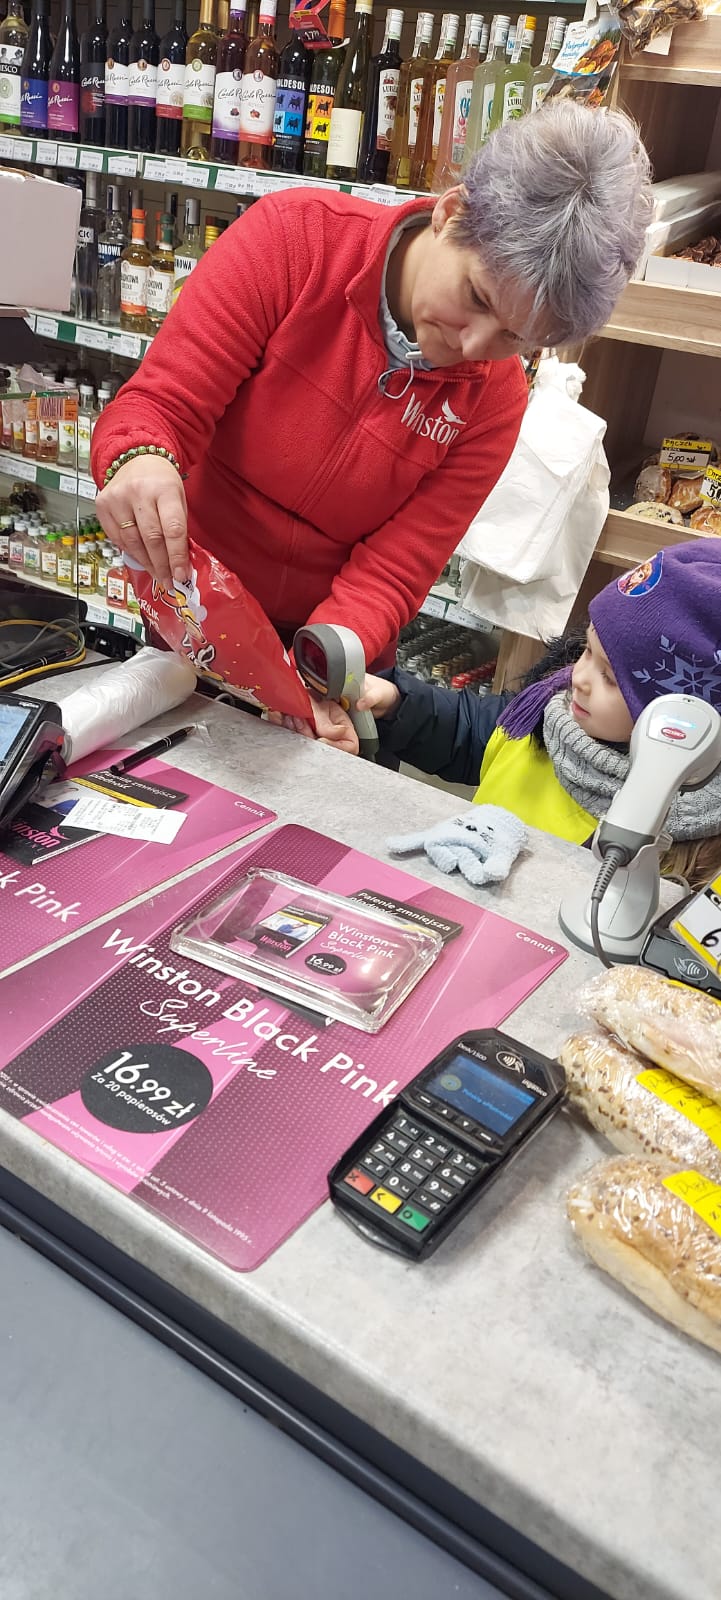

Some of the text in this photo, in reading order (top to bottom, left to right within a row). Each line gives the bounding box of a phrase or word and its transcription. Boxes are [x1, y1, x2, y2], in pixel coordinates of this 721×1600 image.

[401, 392, 459, 446] Winston
[234, 801, 266, 818] Cennik
[11, 820, 61, 849] inston
[13, 882, 82, 924] Pink
[358, 892, 452, 932] Palenie zmniejsza
[339, 922, 389, 947] Winston
[515, 930, 557, 955] Cennik
[328, 930, 395, 959] Black Pink
[309, 955, 335, 969] 16.99
[102, 928, 221, 1008] Winston
[221, 998, 319, 1063] Black
[319, 1052, 401, 1108] Pink
[139, 998, 278, 1080] Superline
[103, 1051, 196, 1119] 16.99 zł
[104, 1080, 121, 1092] 20
[115, 1090, 172, 1126] papierosów
[399, 1119, 407, 1128] 1
[386, 1131, 395, 1140] 4
[373, 1144, 385, 1153] 7
[412, 1148, 424, 1159] 5
[424, 1136, 448, 1154] 2 ABC
[400, 1163, 412, 1173] 8
[453, 1154, 464, 1164] 3
[389, 1176, 400, 1186] 0
[441, 1168, 452, 1177] 6
[429, 1181, 440, 1191] 9
